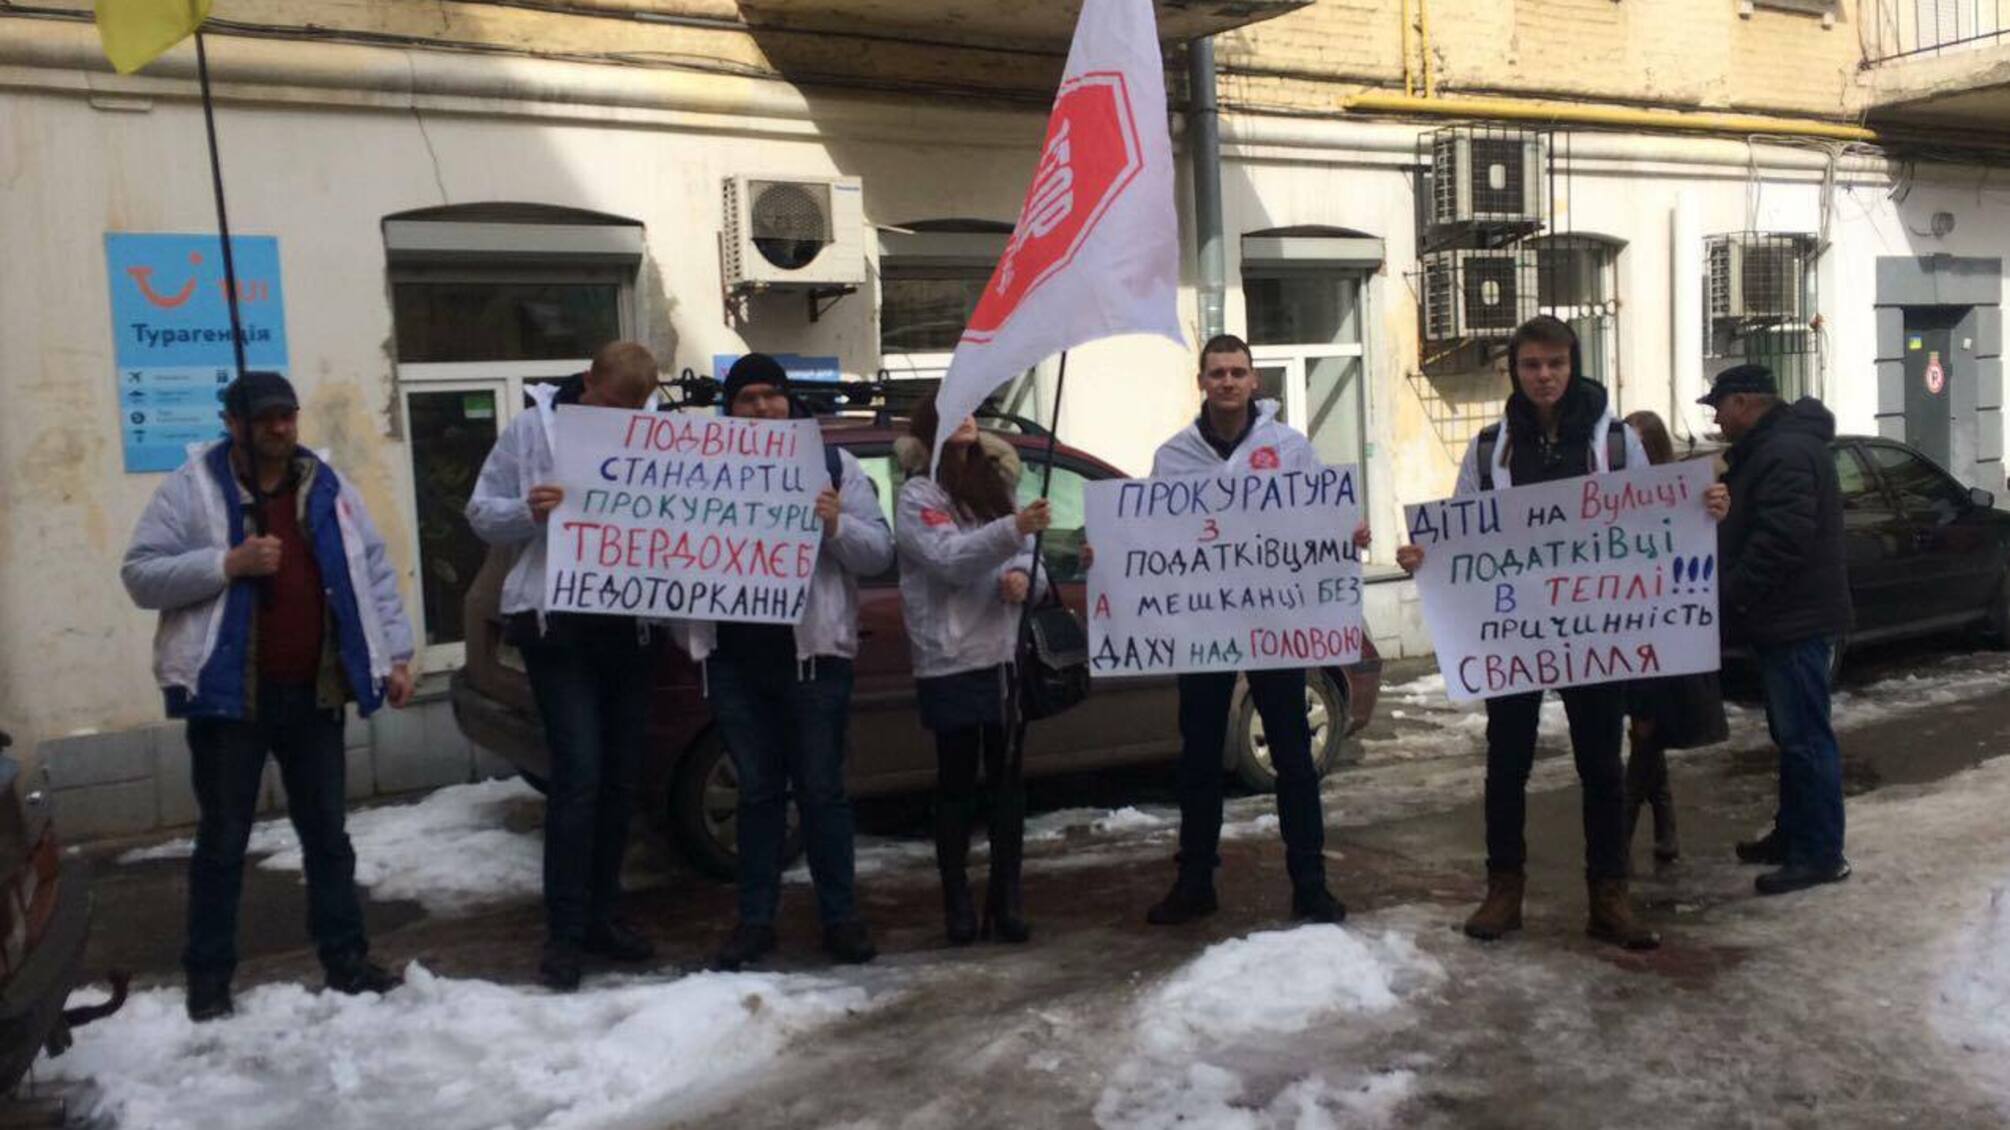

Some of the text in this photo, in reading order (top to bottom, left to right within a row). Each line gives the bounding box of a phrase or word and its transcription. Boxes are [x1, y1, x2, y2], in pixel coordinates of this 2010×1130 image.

[1118, 469, 1356, 518] ПРОКУРАТУРА
[1527, 504, 1567, 528] НА
[563, 522, 815, 579] ТВЕРДОХЛЄБ
[1094, 593, 1111, 620] А
[1318, 577, 1361, 606] БЕЗ
[1495, 583, 1517, 613] В
[1092, 625, 1361, 670] ДАХУ НАД ГОЛОВОЮ
[1459, 643, 1661, 693] СВАВІЛЛЯ
